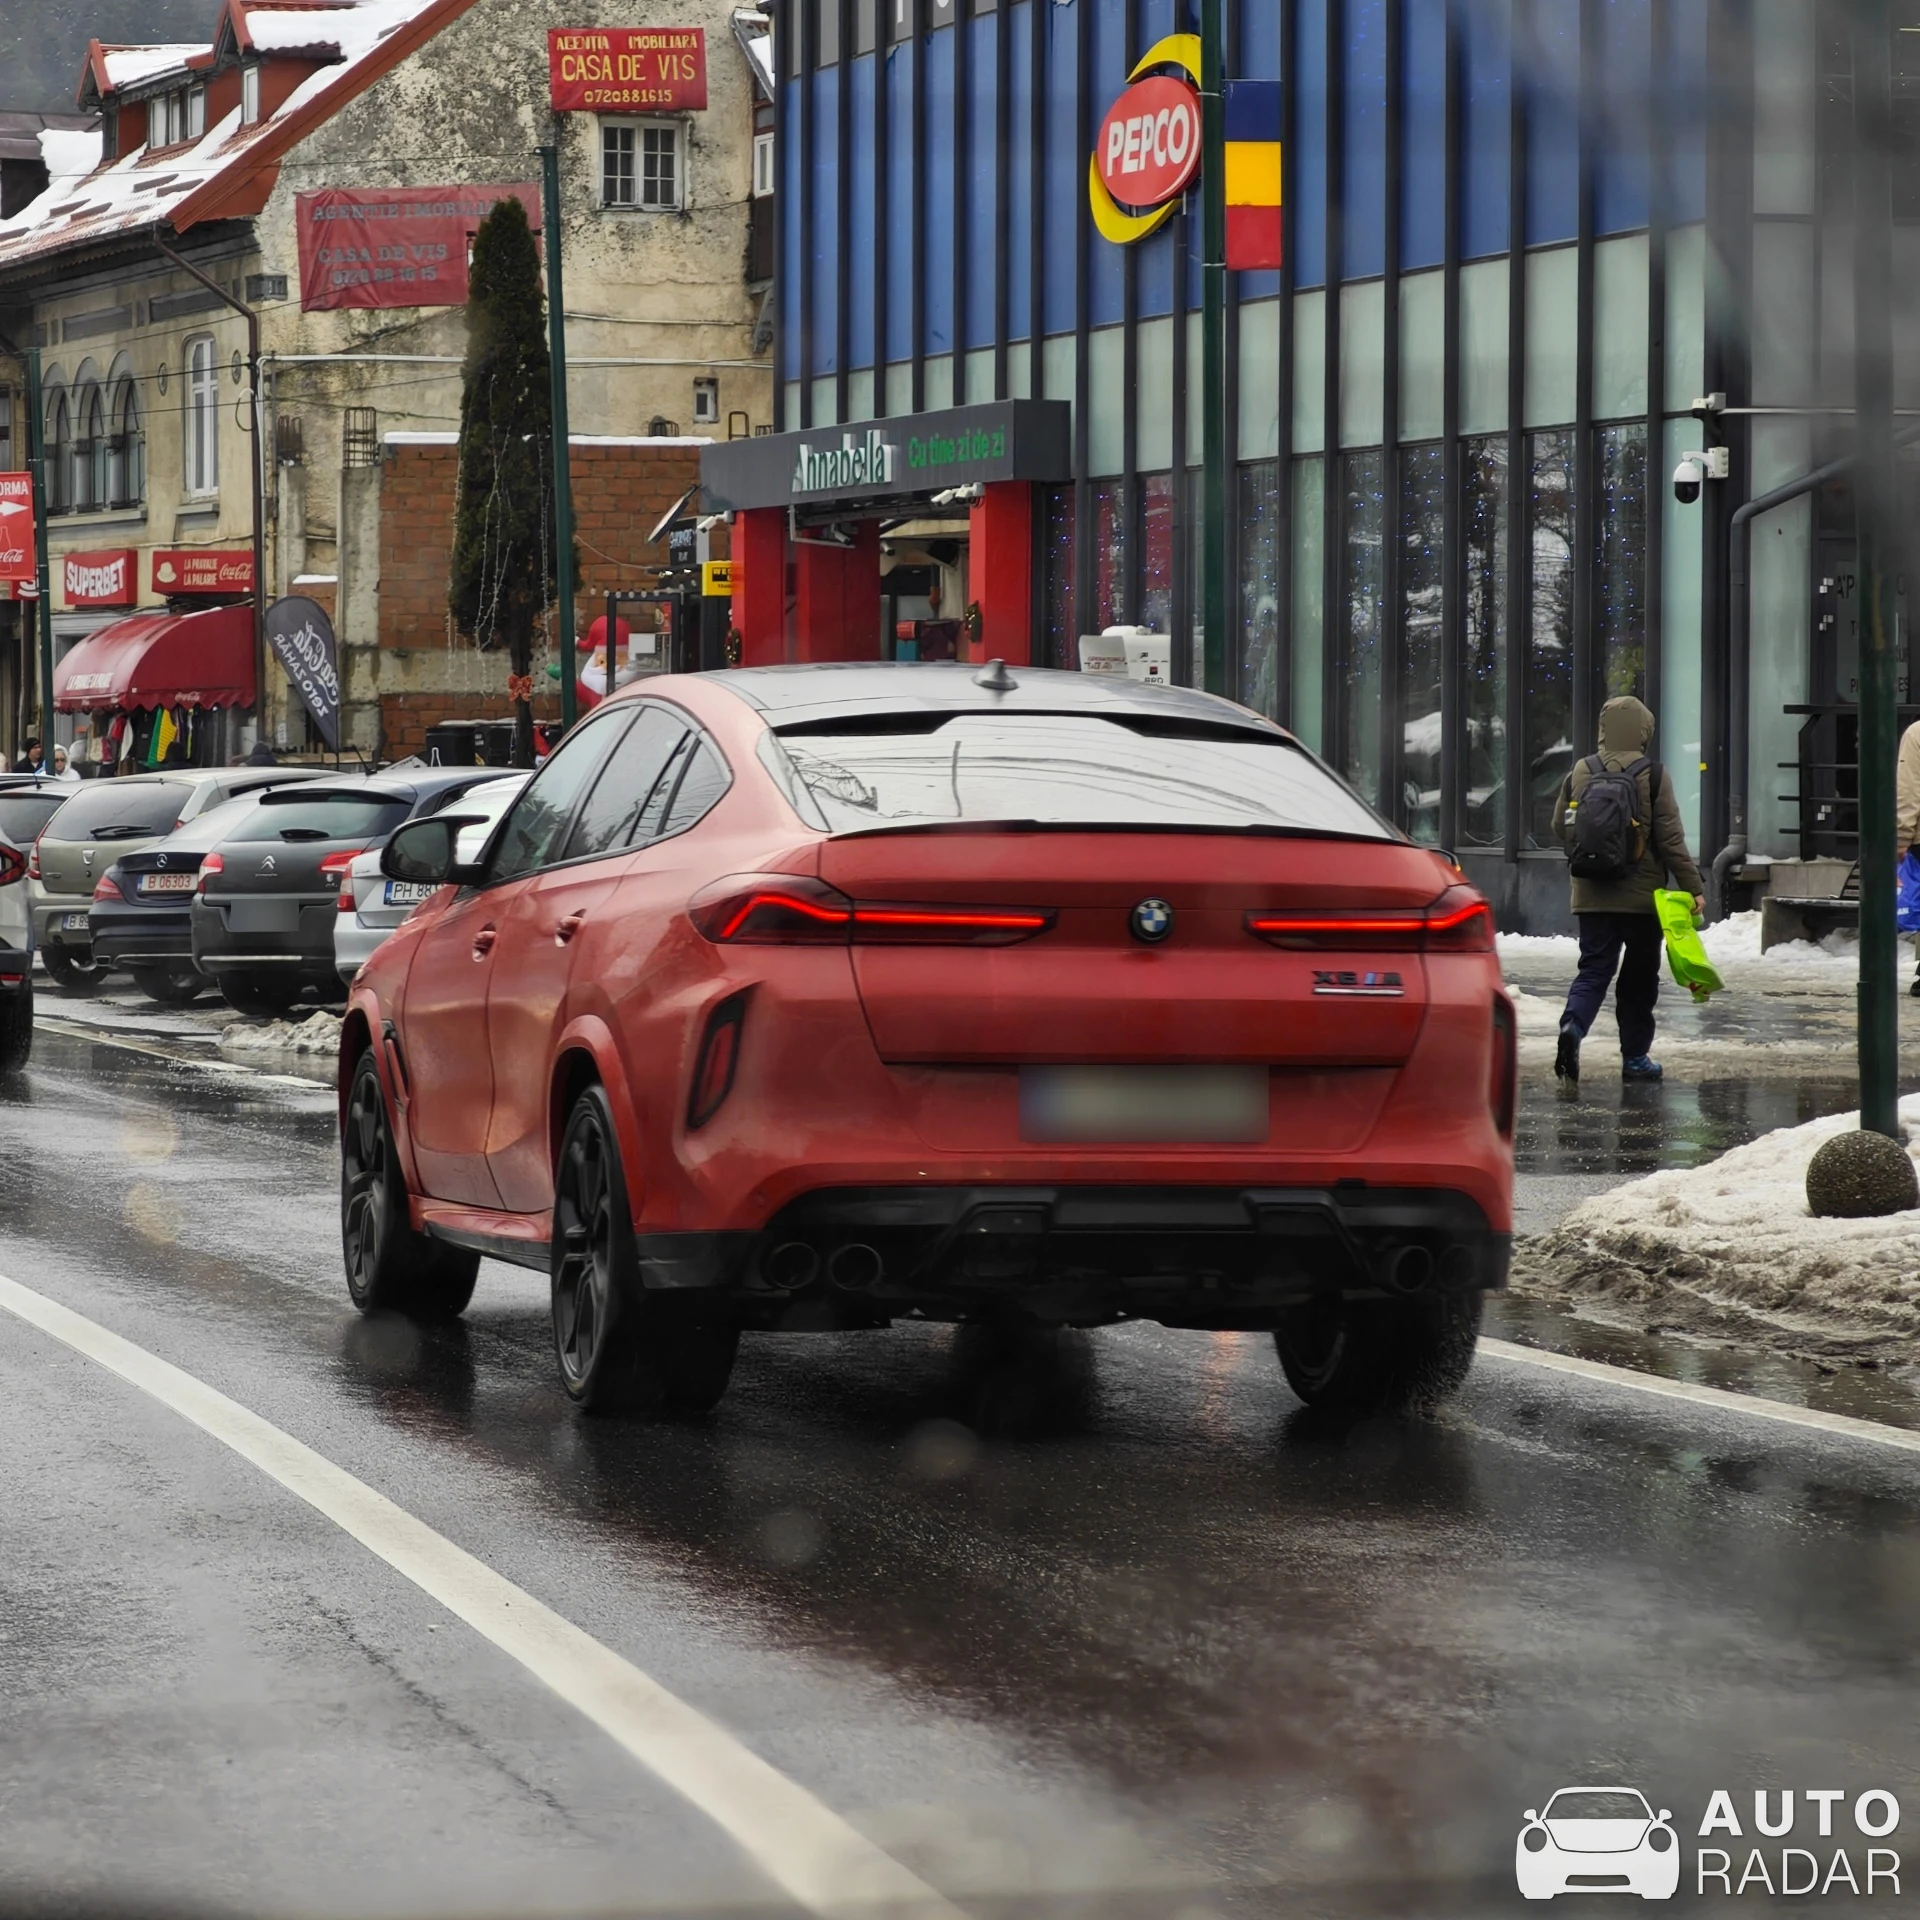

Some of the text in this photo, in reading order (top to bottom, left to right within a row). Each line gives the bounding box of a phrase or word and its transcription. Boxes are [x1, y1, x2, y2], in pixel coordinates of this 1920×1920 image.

[561, 54, 696, 82] CASA DE VIS
[584, 89, 673, 103] 0720881615
[1106, 103, 1190, 178] PEPCO
[318, 243, 447, 264] CASA DE VIS
[908, 424, 1005, 468] Cu tine zi de zi
[791, 429, 892, 493] Annabella
[66, 556, 125, 598] SUPERBET
[148, 875, 191, 889] B 06303
[393, 883, 412, 898] PH
